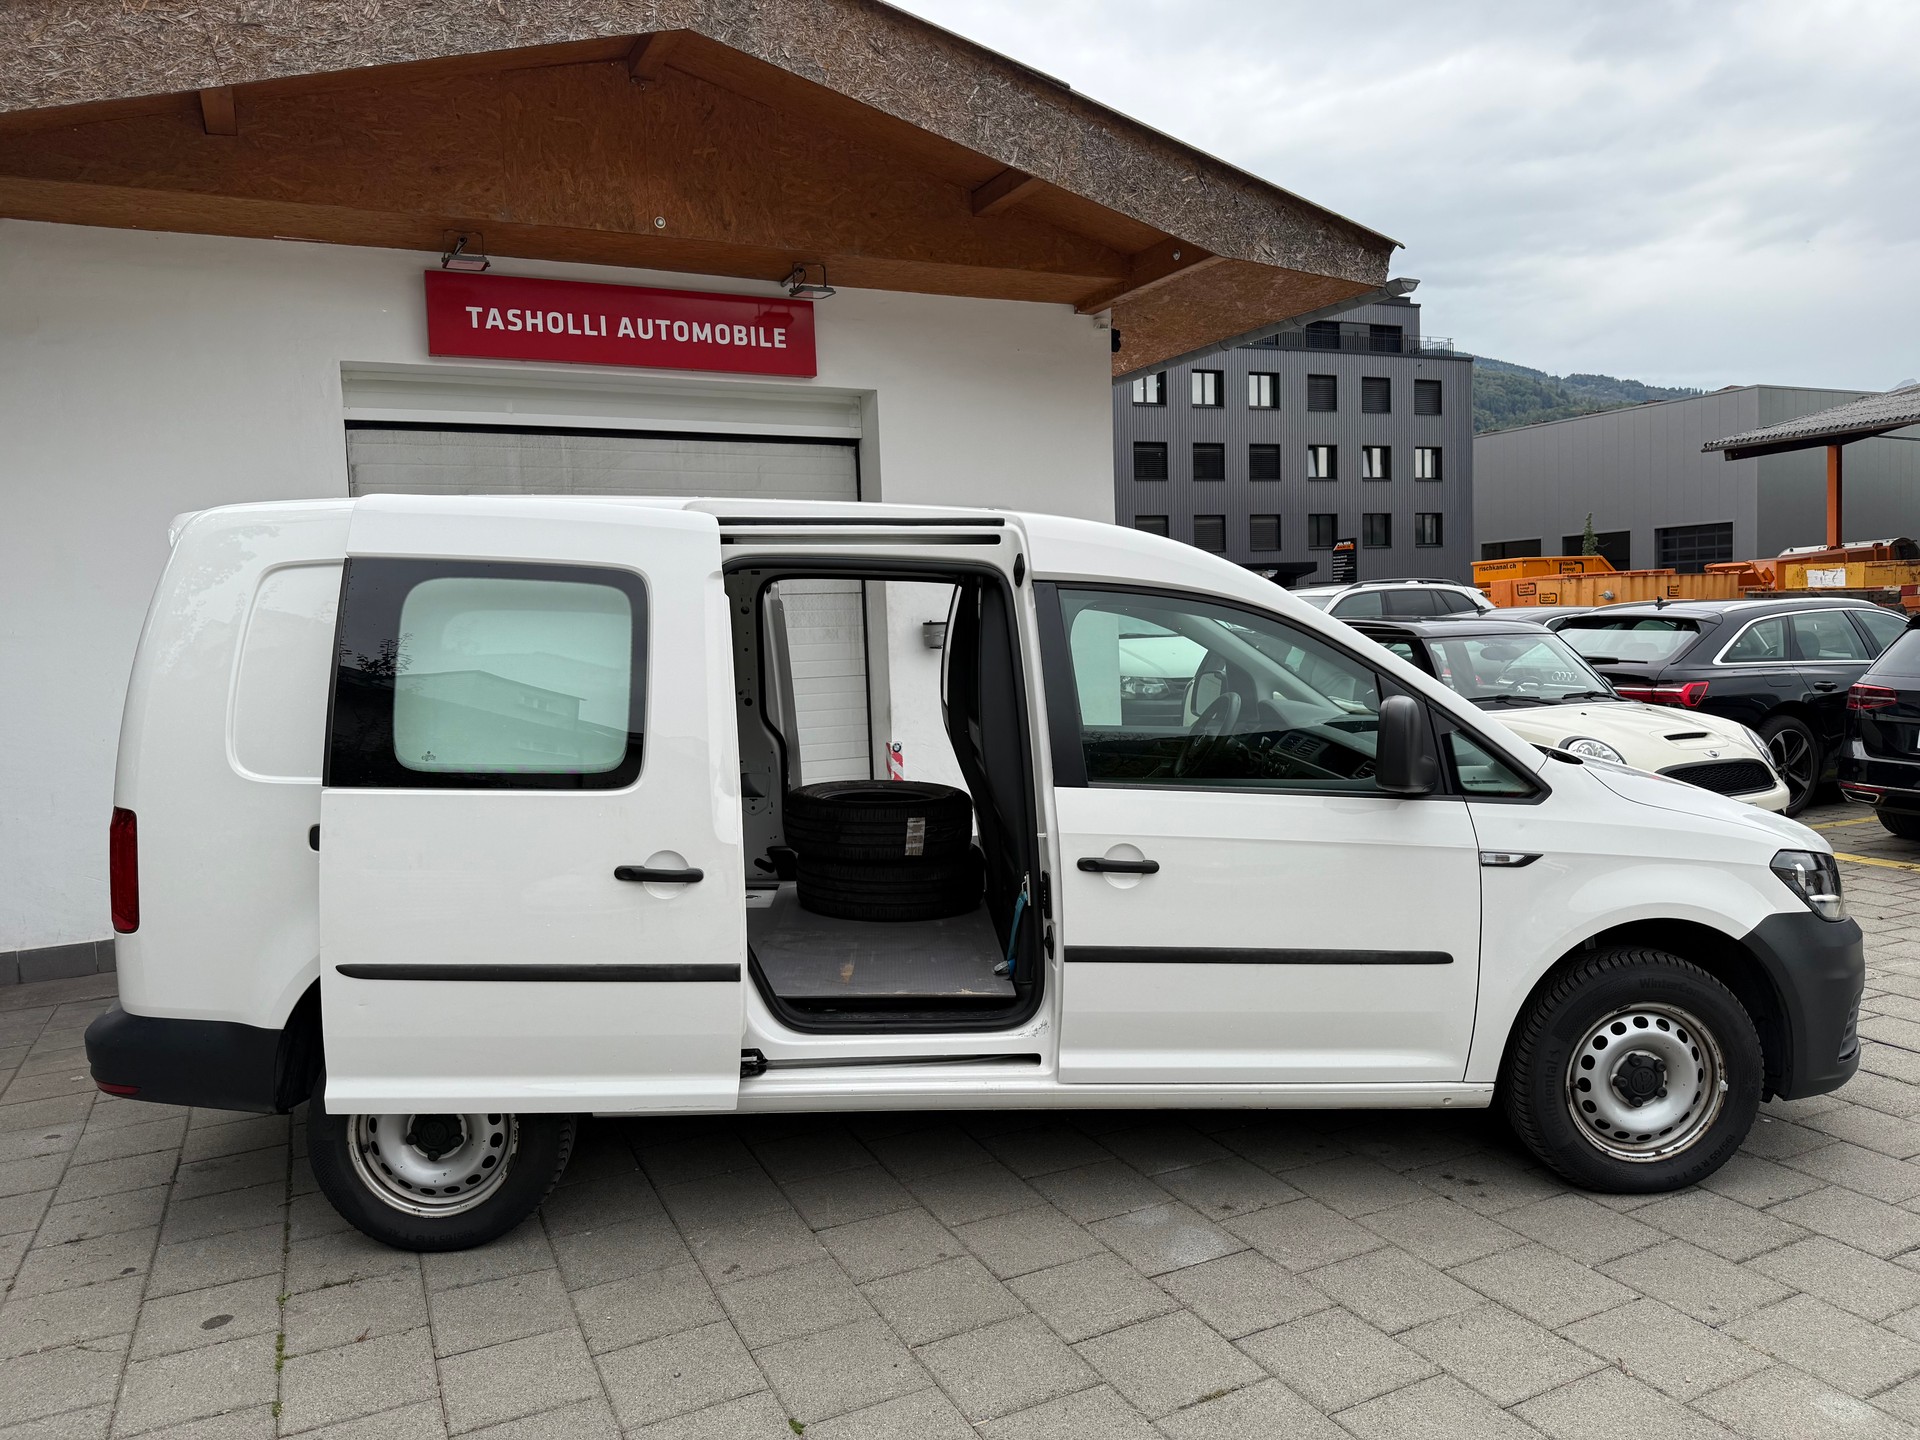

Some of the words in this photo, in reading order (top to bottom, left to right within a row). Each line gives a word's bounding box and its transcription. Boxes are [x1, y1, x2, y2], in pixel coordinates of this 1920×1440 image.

[465, 306, 607, 337] TASHOLLI
[617, 316, 787, 349] AUTOMOBILE
[1709, 1134, 1736, 1161] 195/65
